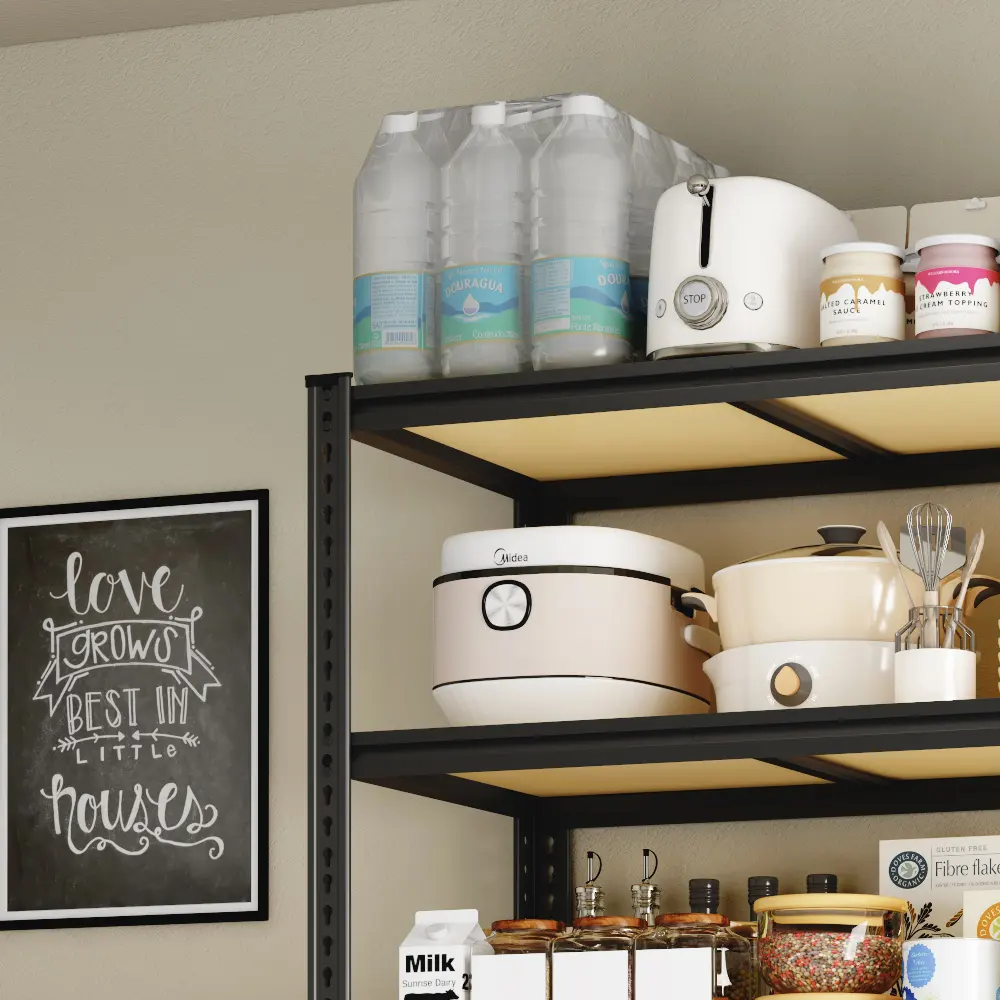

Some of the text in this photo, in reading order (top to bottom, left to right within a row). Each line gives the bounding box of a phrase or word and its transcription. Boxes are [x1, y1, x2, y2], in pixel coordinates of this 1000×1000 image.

[683, 294, 706, 304] STOP
[948, 299, 988, 308] TOPPING
[494, 548, 528, 565] Midea
[50, 551, 184, 615] love
[66, 685, 189, 735] BEST IN
[41, 773, 224, 860] houses
[890, 854, 926, 873] DOVES FARM
[935, 859, 969, 877] Fibre
[891, 874, 925, 888] ORGANIC
[980, 907, 1000, 938] DOVES
[405, 953, 456, 973] Milk
[402, 979, 456, 988] Sunrise Dairy
